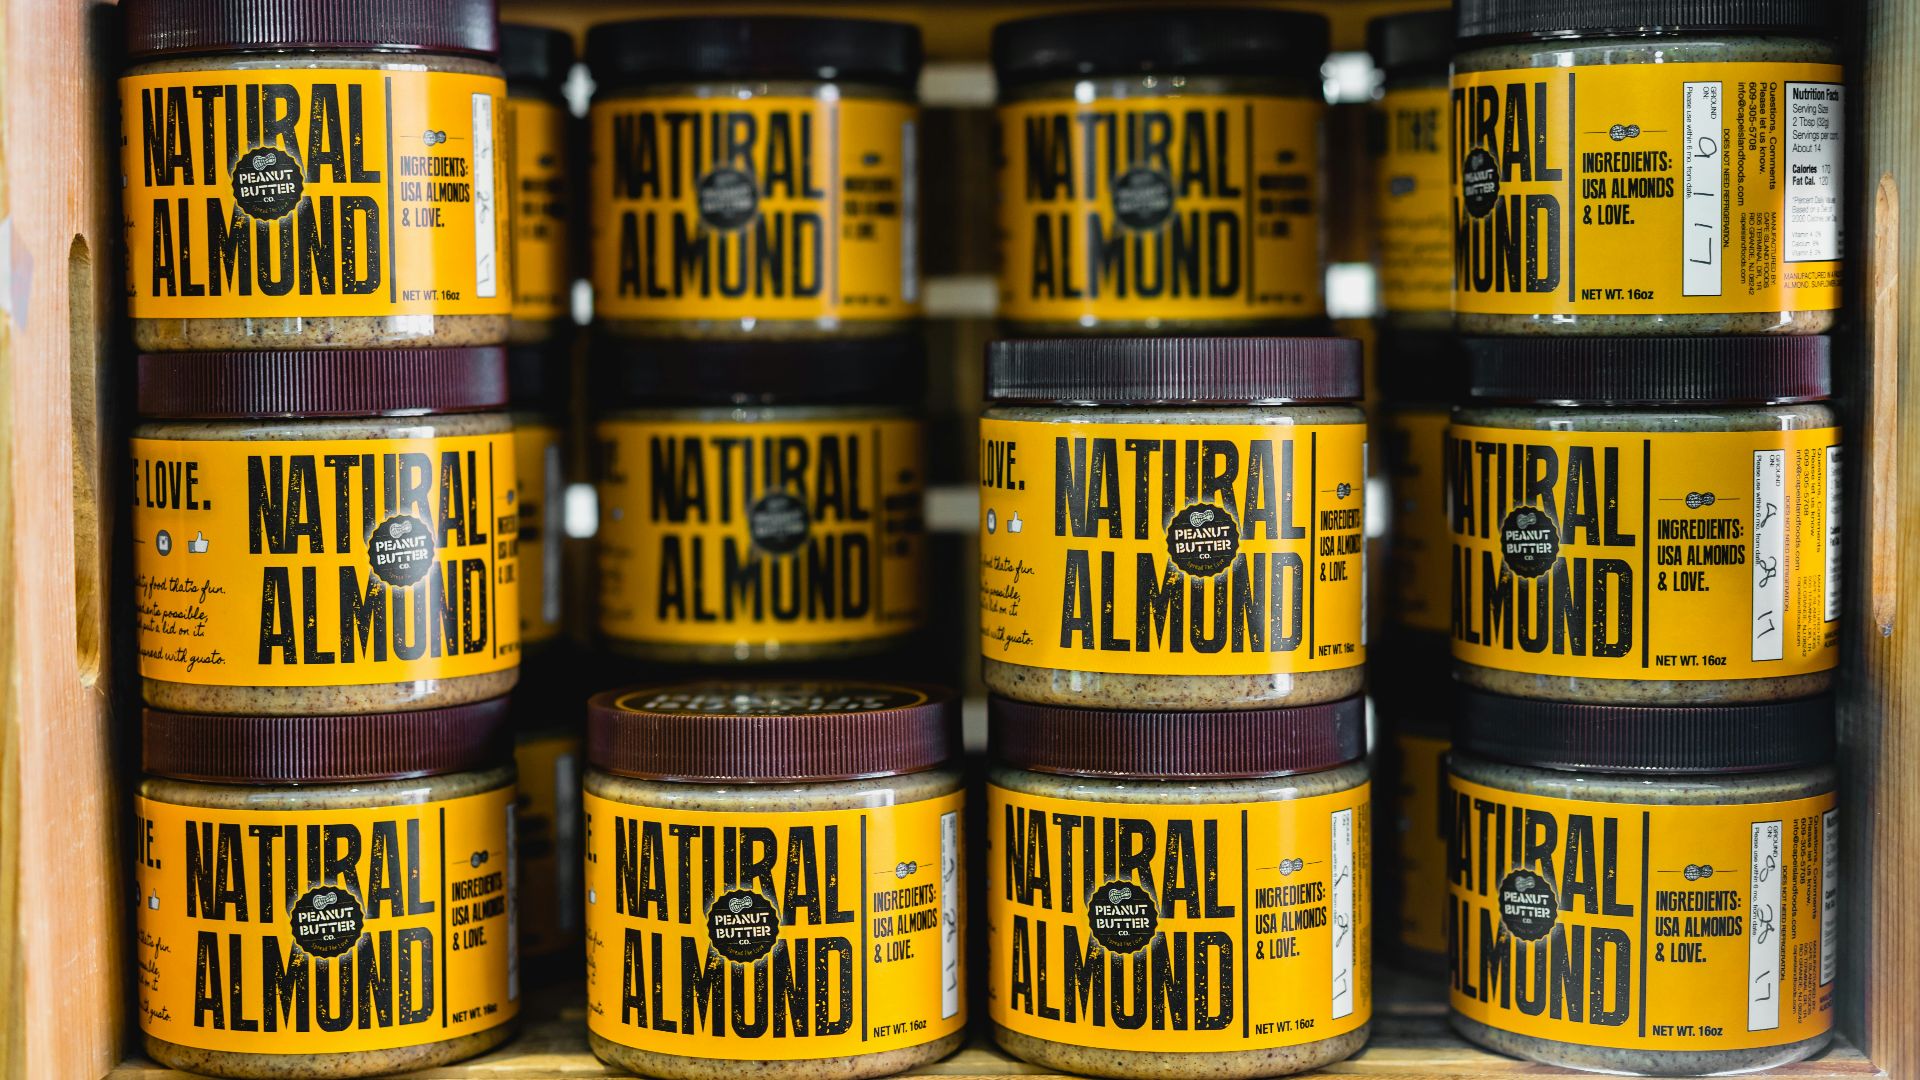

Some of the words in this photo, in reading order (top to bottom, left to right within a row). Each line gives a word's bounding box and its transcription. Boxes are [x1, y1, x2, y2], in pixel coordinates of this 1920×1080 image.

[1793, 88, 1824, 100] Nutrition
[1826, 88, 1838, 101] Facts
[1749, 82, 1757, 150] 609-305-5708
[1769, 82, 1778, 134] Questions,
[1793, 104, 1816, 115] Serving
[1818, 104, 1828, 114] Size
[1793, 116, 1797, 126] 2
[1799, 116, 1815, 128] Tbsp
[141, 83, 380, 187] NATURAL
[1736, 82, 1746, 206] info@capeislandfoods.com
[1760, 132, 1766, 144] us
[1793, 130, 1819, 141] Servings
[612, 111, 824, 200] NATURAL
[1024, 109, 1240, 200] NATURAL
[1694, 137, 1717, 158] 9
[1792, 144, 1812, 152] About
[1814, 144, 1821, 152] 14
[401, 156, 468, 177] INGREDIENTS:
[1582, 151, 1672, 172] INGREDIENTS:
[1770, 136, 1778, 190] Comments
[1792, 164, 1817, 174] Calories
[239, 170, 293, 184] PEANUT
[1792, 176, 1802, 186] Fat
[1804, 176, 1815, 186] Cal.
[241, 183, 296, 198] BUTTER
[401, 183, 422, 202] USA
[426, 182, 470, 202] ALMONDS
[1582, 180, 1608, 199] USA
[1611, 178, 1673, 198] ALMONDS
[402, 208, 410, 227] &
[415, 208, 444, 228] LOVE.
[1582, 207, 1592, 224] &
[1598, 206, 1635, 225] LOVE.
[152, 195, 380, 297] ALMOND
[618, 211, 823, 298] ALMOND
[1032, 210, 1240, 299] ALMOND
[1749, 262, 1754, 272] NJ
[1582, 289, 1600, 300] NET
[1604, 289, 1624, 300] WT.
[1627, 288, 1654, 300] 16oz
[982, 441, 1025, 490] LOVE.
[146, 462, 211, 510] LOVE.
[649, 434, 869, 524] NATURAL
[1055, 437, 1305, 539] NATURAL
[248, 451, 486, 554] NATURAL
[1174, 526, 1230, 540] PEANUT
[1506, 529, 1550, 541] PEANUT
[1658, 519, 1744, 540] INGREDIENTS:
[376, 535, 426, 553] PEANUT
[1176, 540, 1232, 554] BUTTER
[1320, 537, 1334, 556] USA
[1337, 534, 1361, 555] ALMONDS
[1506, 541, 1552, 554] BUTTER
[377, 549, 428, 564] BUTTER
[1658, 548, 1682, 566] USA
[1687, 544, 1745, 565] ALMONDS
[658, 532, 869, 622] ALMOND
[1320, 564, 1326, 581] &
[1329, 560, 1348, 581] LOVE.
[200, 580, 225, 603] fun.
[1658, 574, 1667, 591] &
[1674, 571, 1709, 592] LOVE.
[258, 558, 486, 665] ALMOND
[1060, 549, 1302, 653] ALMOND
[162, 606, 208, 622] possible,
[1758, 610, 1775, 638] 17
[163, 621, 176, 634] lid
[1004, 629, 1033, 651] gusto.
[166, 648, 187, 662] with
[187, 650, 226, 672] gusto.
[1656, 655, 1675, 666] NET
[1678, 655, 1699, 666] WT.
[1702, 655, 1727, 667] 16oz
[185, 819, 435, 923] NATURAL
[615, 816, 854, 926] NATURAL
[1005, 803, 1235, 919] NATURAL
[873, 885, 936, 912] INGREDIENTS:
[1255, 881, 1326, 909] INGREDIENTS:
[1504, 891, 1549, 905] PEANUT
[1656, 890, 1741, 912] INGREDIENTS:
[298, 907, 354, 922] PEANUT
[452, 906, 469, 926] USA
[715, 912, 770, 926] PEANUT
[1095, 905, 1148, 916] PEANUT
[1256, 913, 1278, 935] USA
[1281, 907, 1327, 932] ALMONDS
[1504, 904, 1550, 919] BUTTER
[300, 920, 356, 936] BUTTER
[716, 926, 772, 938] BUTTER
[874, 918, 894, 938] USA
[897, 908, 937, 935] ALMONDS
[1096, 918, 1150, 928] BUTTER
[1656, 917, 1680, 936] USA
[1684, 914, 1742, 936] ALMONDS
[452, 934, 460, 951] &
[464, 928, 487, 950] LOVE.
[1256, 942, 1265, 960] &
[1270, 937, 1300, 959] LOVE.
[874, 946, 882, 963] &
[886, 942, 914, 962] LOVE.
[1655, 944, 1665, 961] &
[1670, 942, 1707, 963] LOVE.
[194, 927, 434, 1032] ALMOND
[622, 928, 852, 1038] ALMOND
[1011, 914, 1234, 1031] ALMOND
[873, 1026, 890, 1038] NET
[893, 1024, 908, 1035] WT.
[910, 1019, 927, 1033] 16oz
[1255, 1023, 1274, 1036] NET
[1276, 1021, 1293, 1033] WT.
[1294, 1017, 1315, 1031] 16oz
[1653, 1025, 1672, 1037] NET
[1675, 1025, 1696, 1037] WT.
[1699, 1024, 1723, 1037] 16oz
